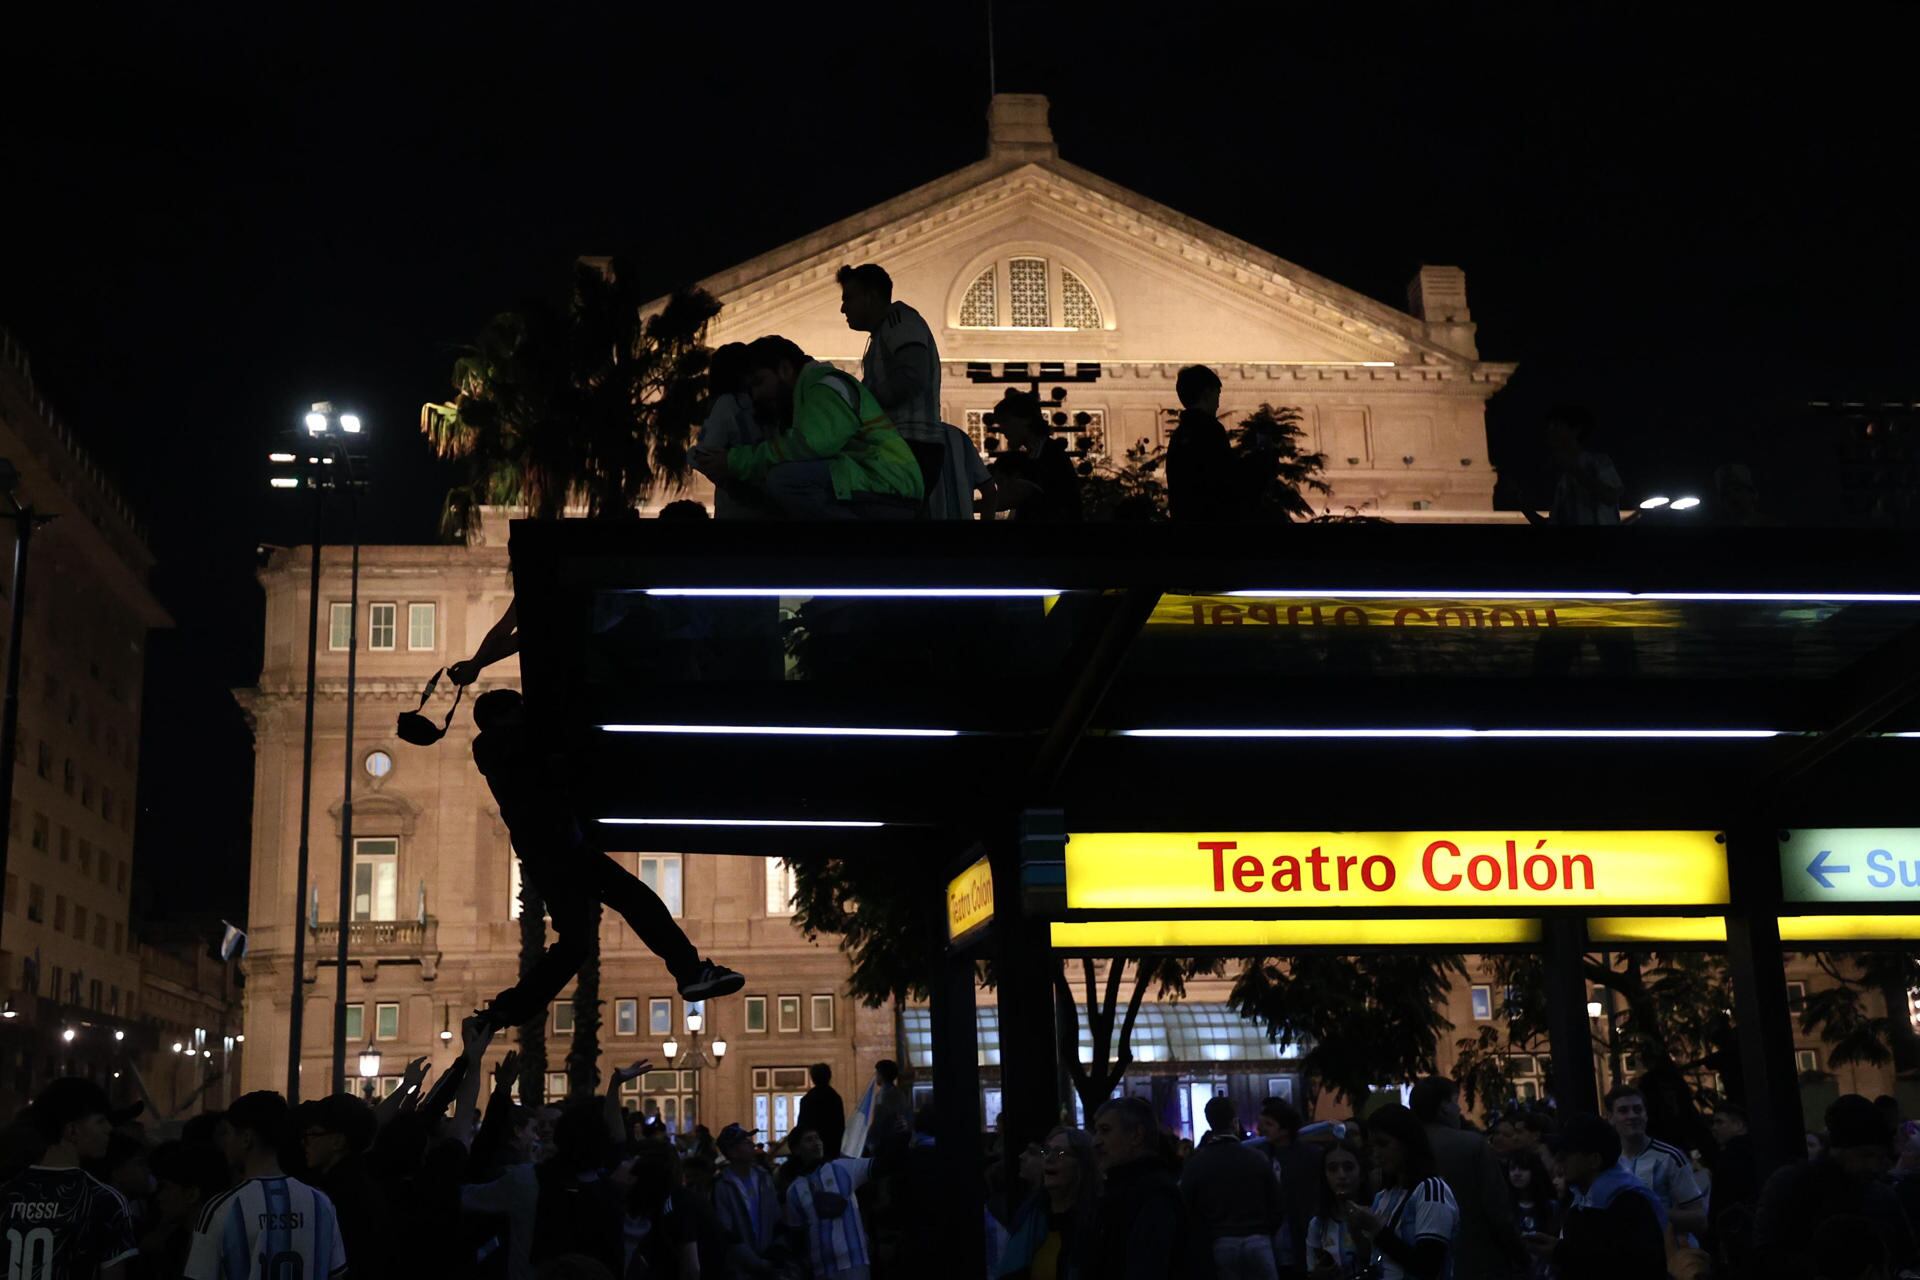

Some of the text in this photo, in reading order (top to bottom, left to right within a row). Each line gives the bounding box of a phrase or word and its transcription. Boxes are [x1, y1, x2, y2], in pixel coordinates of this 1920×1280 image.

[1198, 839, 1595, 893] Teatro Colón
[950, 892, 971, 924] Teatro
[10, 1201, 59, 1220] MESSI
[258, 1211, 304, 1231] MESSI
[6, 1227, 55, 1280] 10
